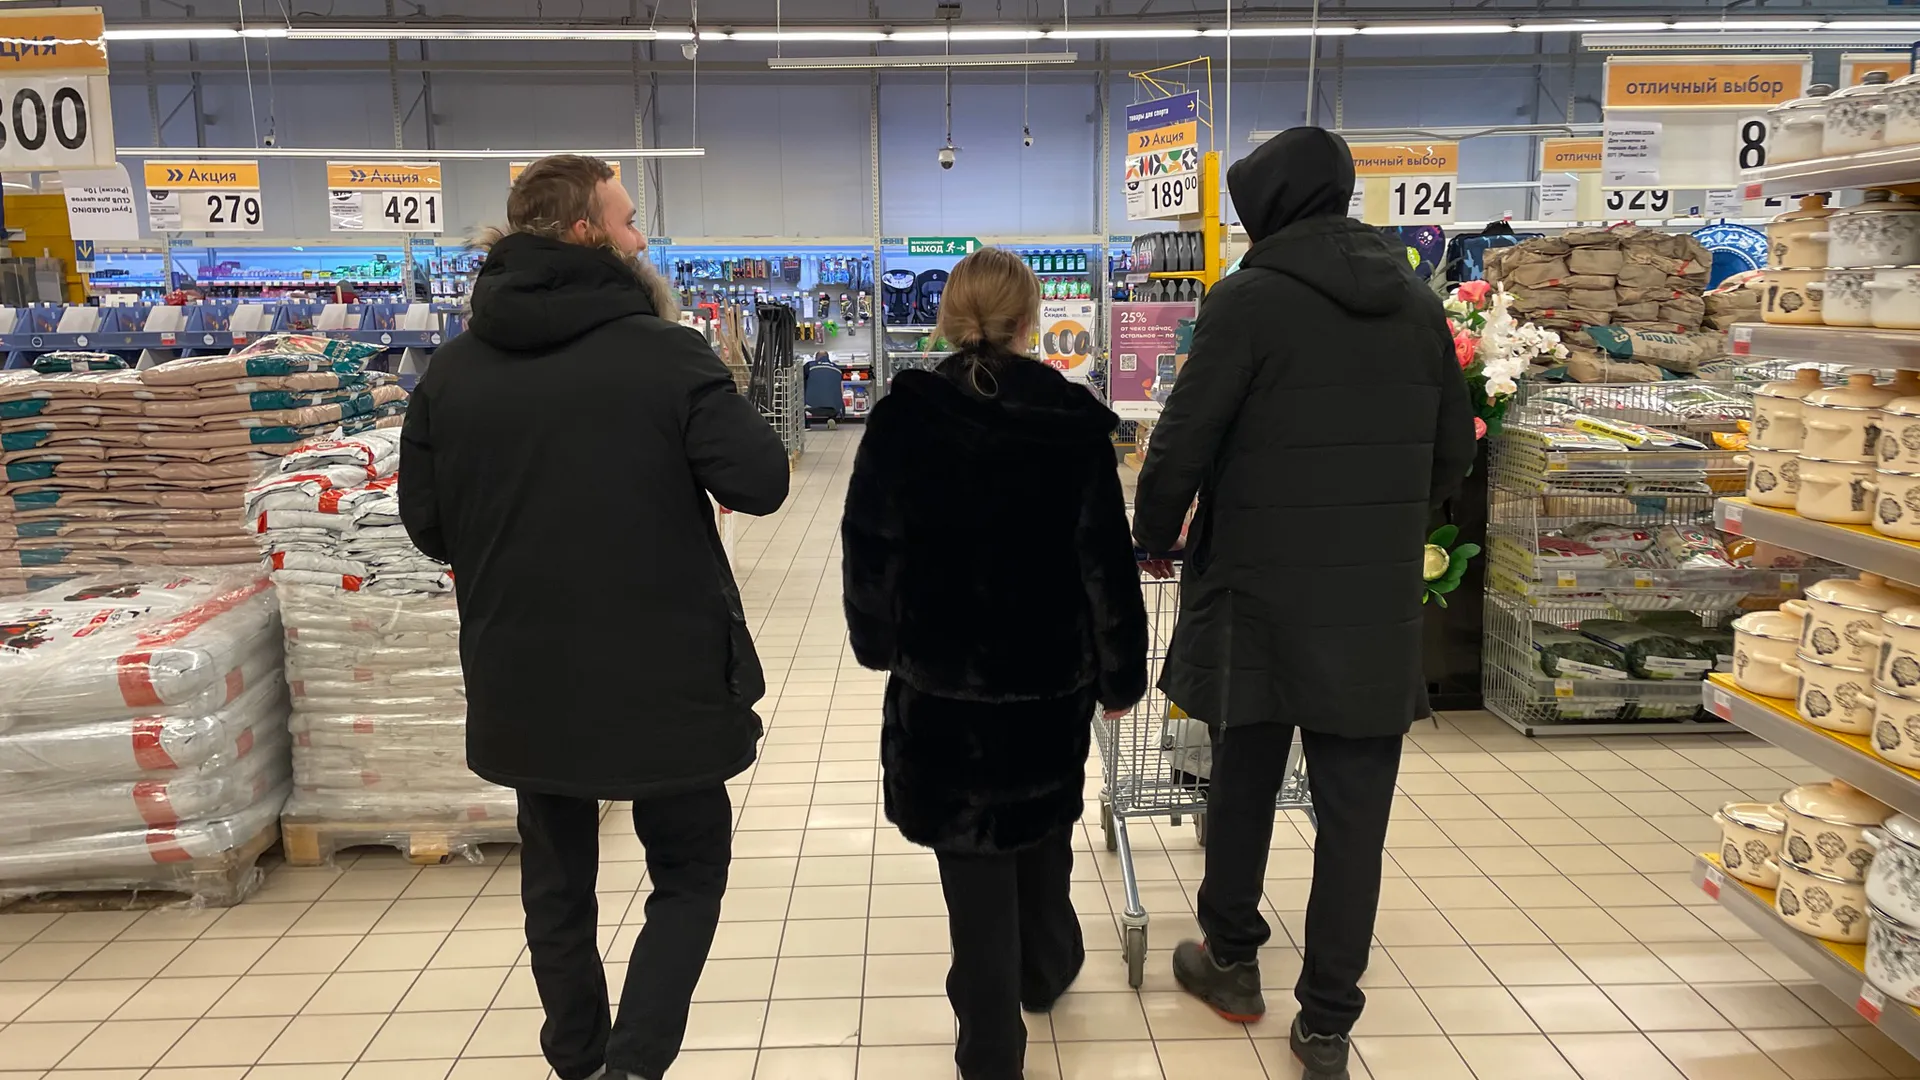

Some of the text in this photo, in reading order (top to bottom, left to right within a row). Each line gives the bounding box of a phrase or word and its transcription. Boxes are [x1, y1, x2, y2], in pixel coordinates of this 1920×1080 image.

[0, 35, 57, 61] ция
[1626, 74, 1783, 97] отличный выбор
[0, 86, 87, 150] 00
[1129, 108, 1169, 121] товары для спорта
[1152, 132, 1184, 145] Акция
[1739, 120, 1766, 169] 8
[1353, 153, 1447, 168] тличный выбор
[188, 168, 236, 183] Акция
[371, 169, 419, 184] Акция
[1152, 180, 1183, 210] 189
[1185, 176, 1197, 190] 00
[1395, 182, 1452, 215] 124
[207, 195, 260, 224] 279
[385, 196, 435, 223] 421
[911, 245, 943, 254] ВЫХОД
[1120, 312, 1147, 323] 25%
